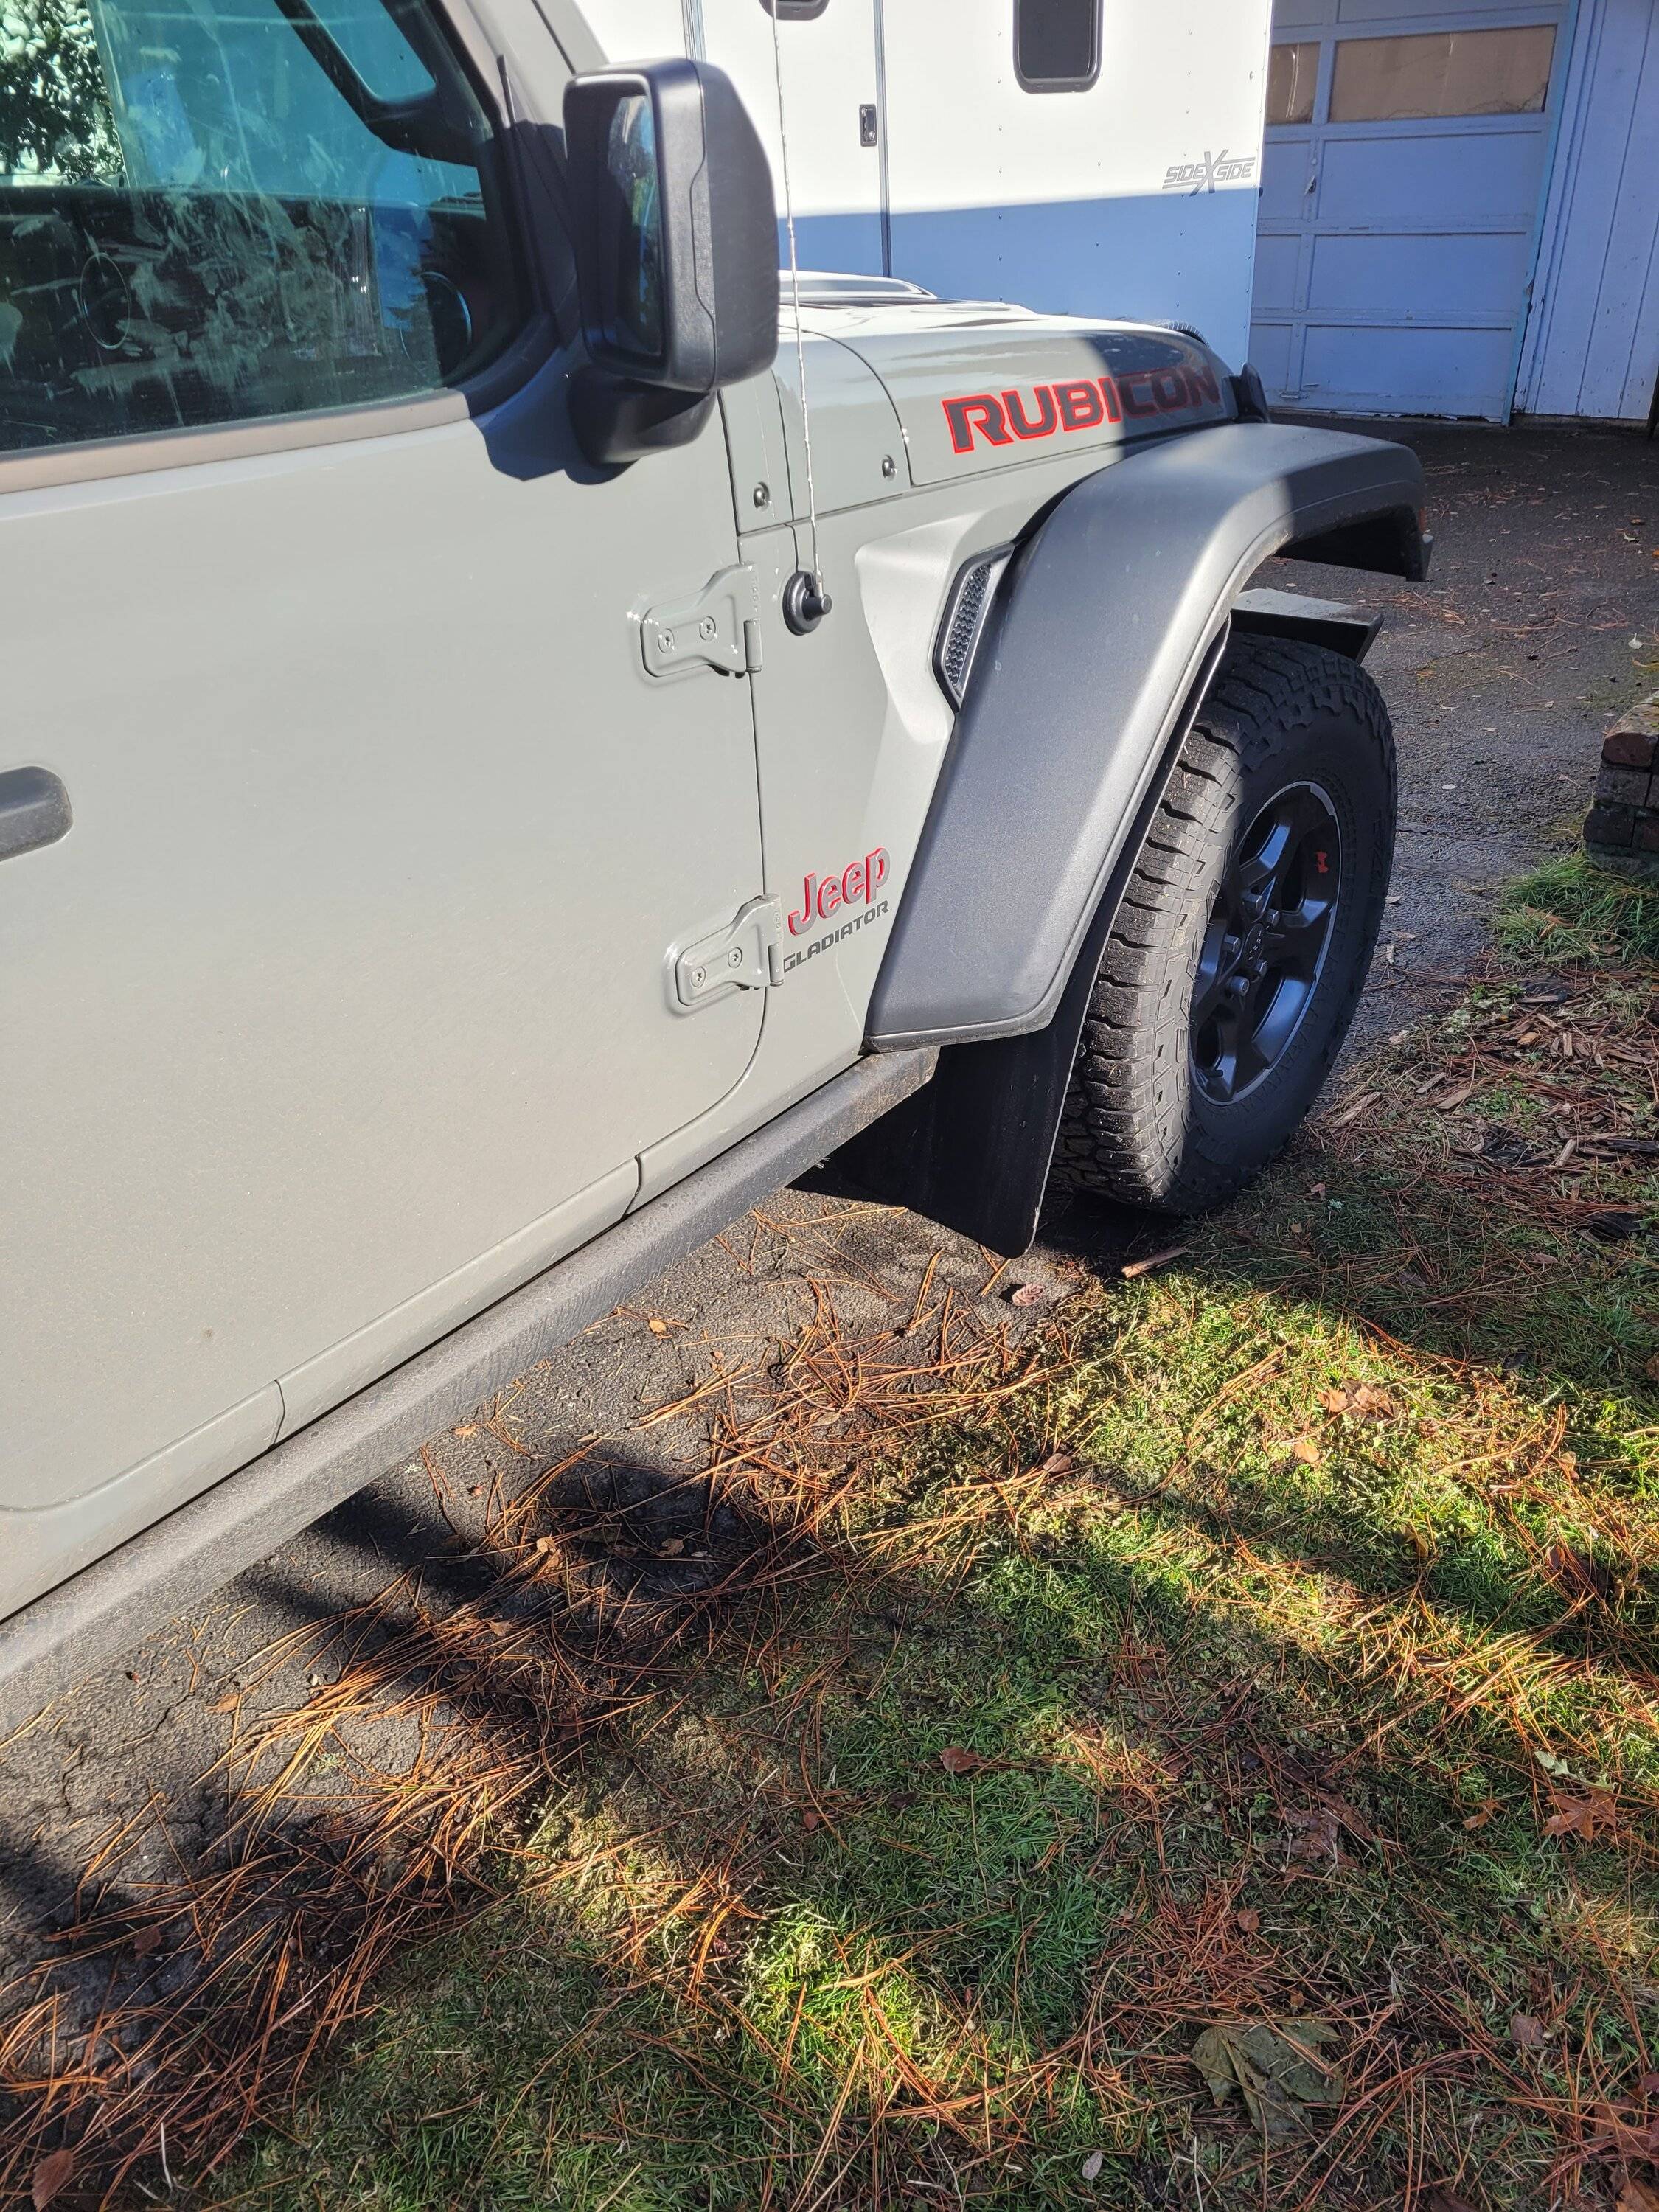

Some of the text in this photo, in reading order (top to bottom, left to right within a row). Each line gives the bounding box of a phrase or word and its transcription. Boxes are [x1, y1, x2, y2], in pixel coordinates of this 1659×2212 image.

[942, 366, 1220, 453] RUBICON
[787, 847, 890, 936] Jeep
[783, 900, 889, 973] GLADIATOR
